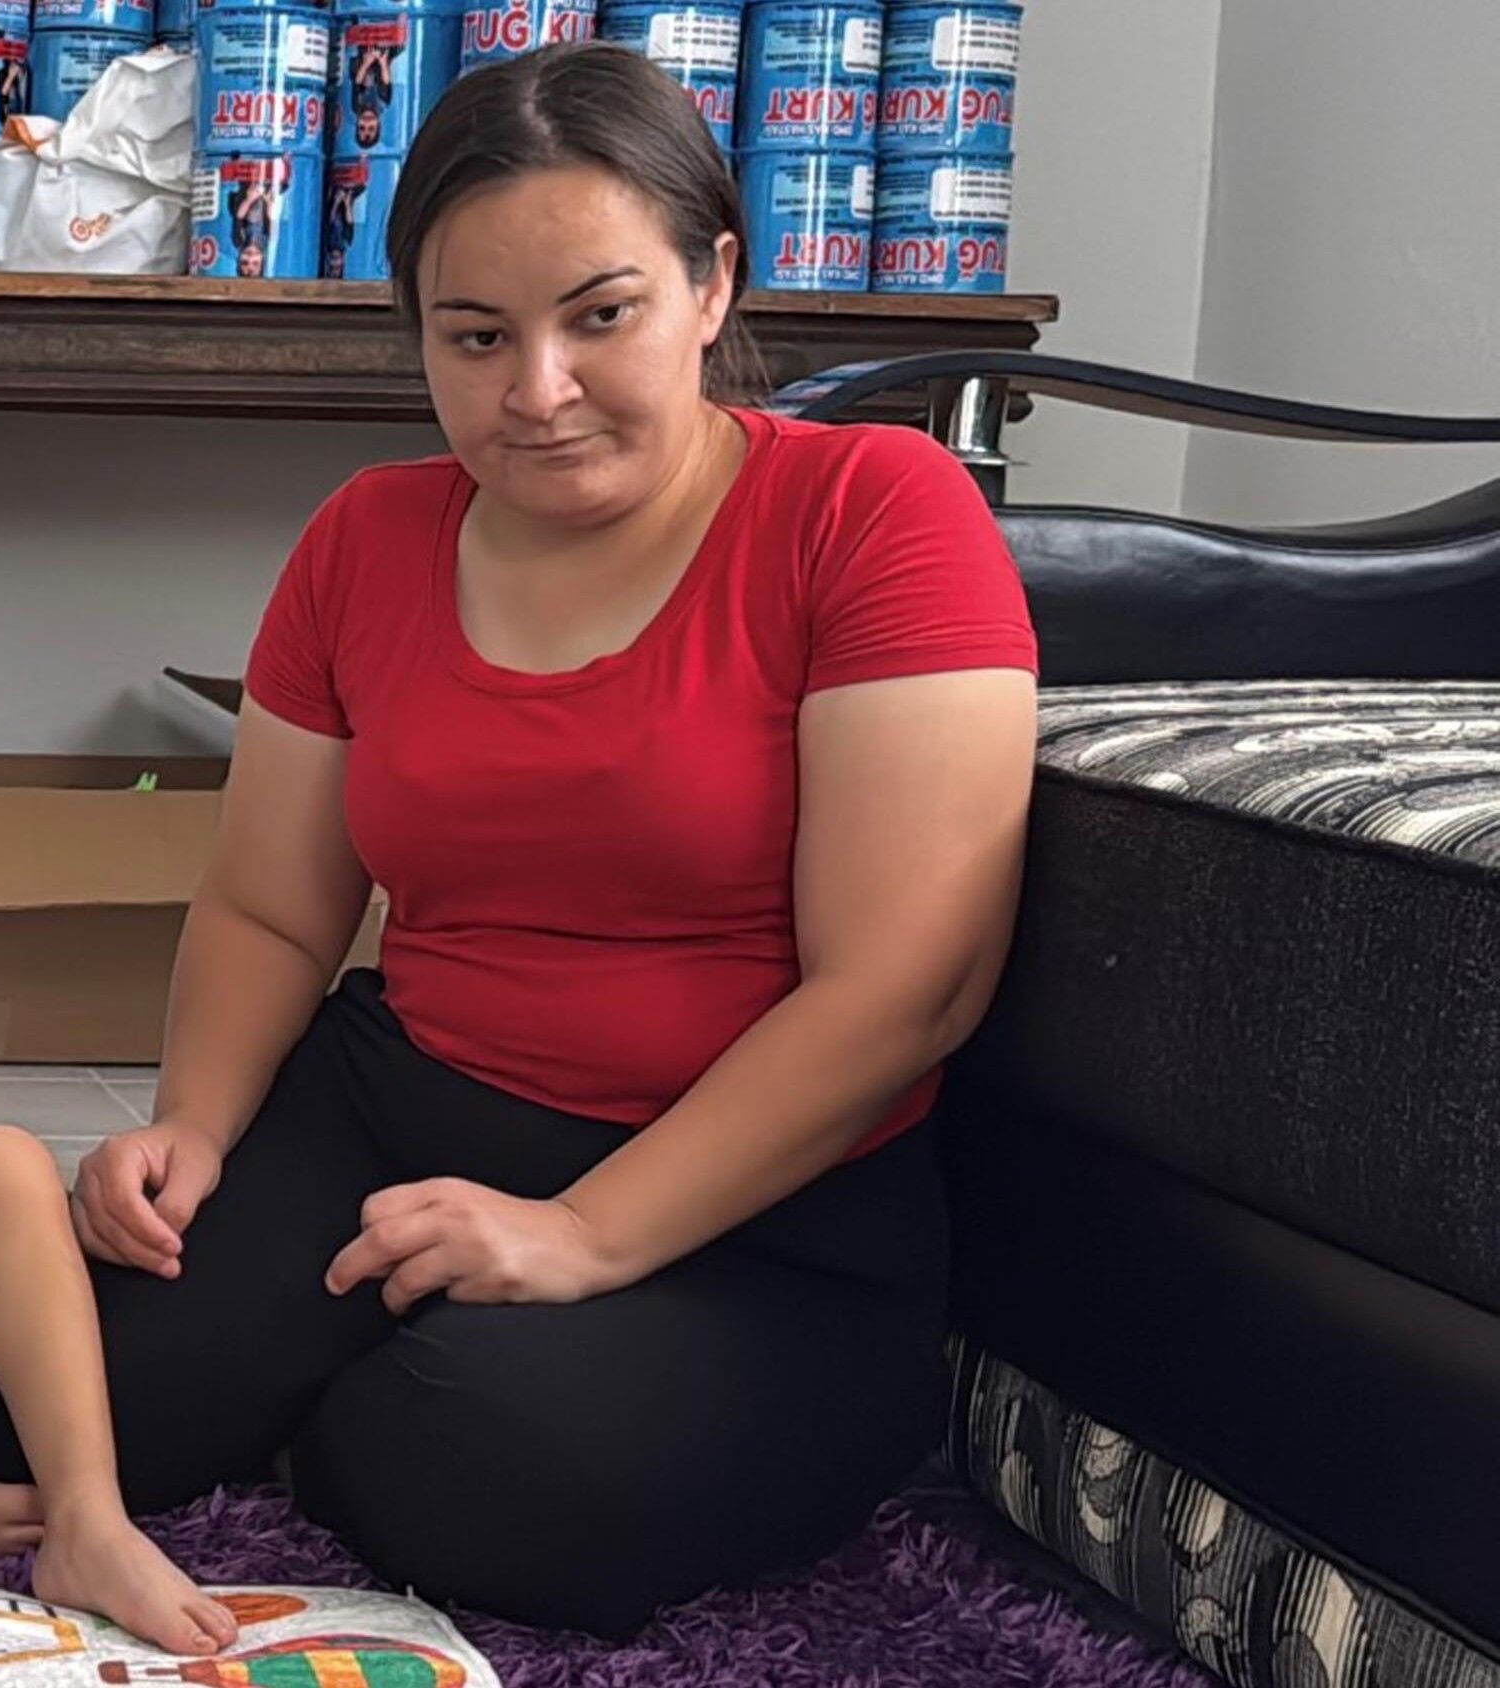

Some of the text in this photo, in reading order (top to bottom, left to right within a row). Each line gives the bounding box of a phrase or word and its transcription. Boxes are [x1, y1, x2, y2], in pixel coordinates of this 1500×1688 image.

[213, 92, 299, 126] KURT
[764, 89, 857, 122] KURT
[775, 234, 862, 267] KURT
